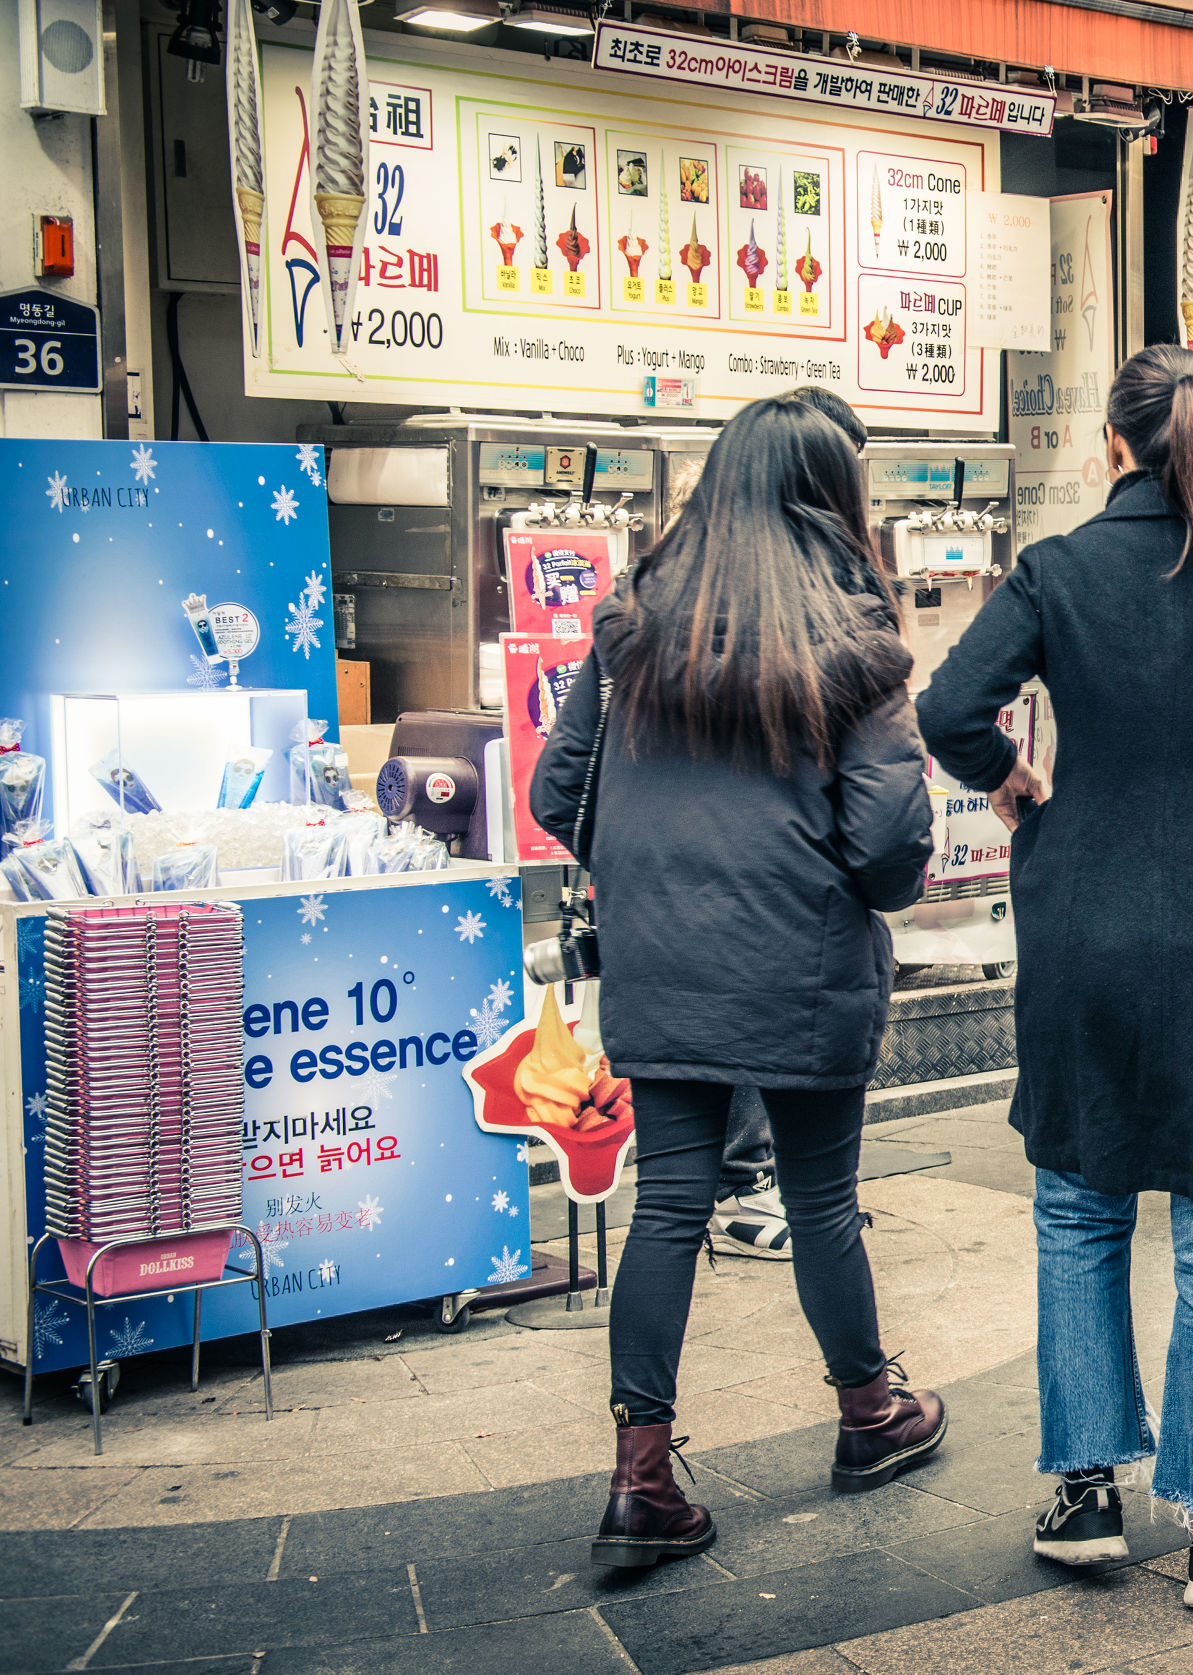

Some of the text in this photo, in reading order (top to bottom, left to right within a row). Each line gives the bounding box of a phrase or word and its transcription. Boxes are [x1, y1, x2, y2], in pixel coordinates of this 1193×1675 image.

[608, 37, 661, 68] 최초로
[814, 71, 873, 104] 개발하여
[877, 80, 921, 109] 판매한
[935, 86, 959, 117] 32
[369, 93, 424, 139] 祖
[887, 168, 961, 194] 32cm Cone
[374, 161, 405, 236] 32
[903, 198, 944, 216] 1가지맛
[913, 241, 947, 262] 2,000
[19, 303, 55, 318] 명동길
[938, 298, 963, 317] CUP
[9, 316, 66, 328] Myeongdong-gil
[911, 322, 952, 338] 3가지맛
[14, 338, 64, 376] 36
[493, 337, 510, 357] Mix
[520, 338, 550, 360] Vanilla
[558, 340, 585, 362] Choco
[617, 344, 634, 365] Plus
[641, 346, 669, 371] Yogurt
[679, 350, 705, 373] Mango
[728, 353, 753, 373] Combo
[760, 355, 799, 382] Strawberry
[806, 358, 827, 378] Green
[829, 360, 841, 380] Tea
[921, 364, 955, 384] 2,000
[60, 487, 149, 508] URBAN CITY
[215, 613, 249, 624] BEST 2
[951, 844, 969, 866] 32
[289, 1028, 478, 1081] essence
[242, 1134, 401, 1182] 으면 늙어요
[266, 1191, 323, 1218] 别发火
[138, 1255, 195, 1277] DOLLKISS
[308, 1264, 341, 1290] CITY
